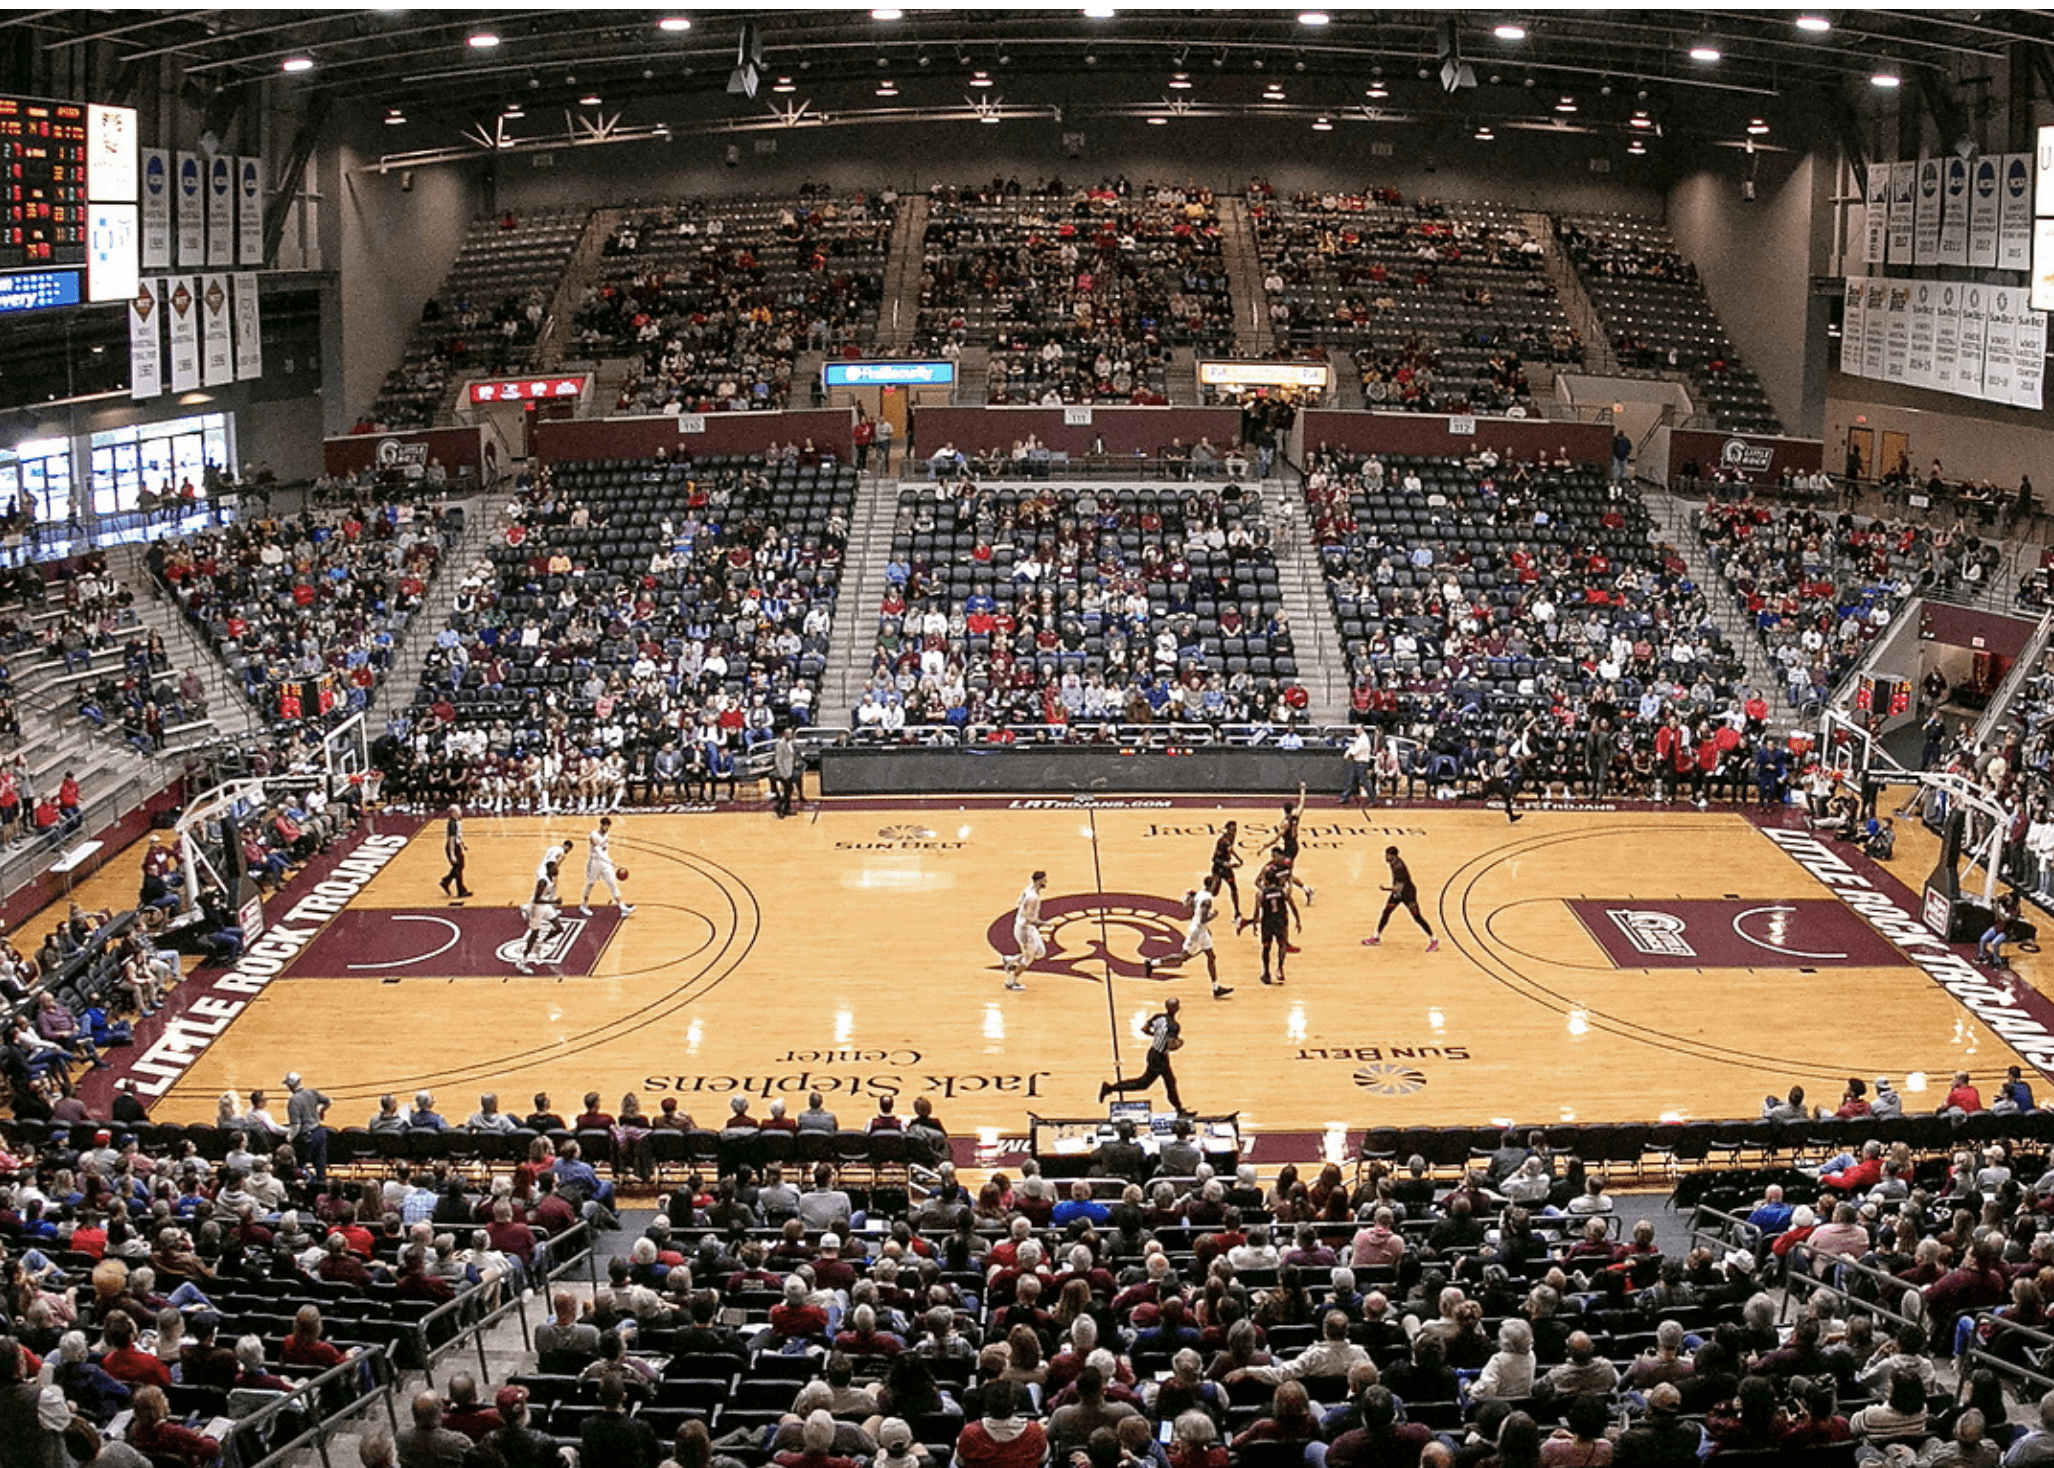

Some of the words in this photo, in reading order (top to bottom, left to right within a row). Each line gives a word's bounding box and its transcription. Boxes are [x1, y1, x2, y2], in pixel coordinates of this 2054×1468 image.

[1243, 823, 1427, 838] Stphens
[1237, 839, 1345, 850] Cter
[1760, 826, 1874, 888] LITTLE
[1833, 887, 1951, 952] ROCK
[113, 995, 248, 1098] LITTLE
[213, 923, 317, 993] ROCK
[283, 833, 409, 923] TROJANS
[776, 1049, 923, 1066] Center
[1294, 1045, 1383, 1061] BELT
[1389, 1045, 1470, 1061] SUN
[642, 1071, 905, 1099] Stephens
[925, 1071, 1052, 1099] Jack
